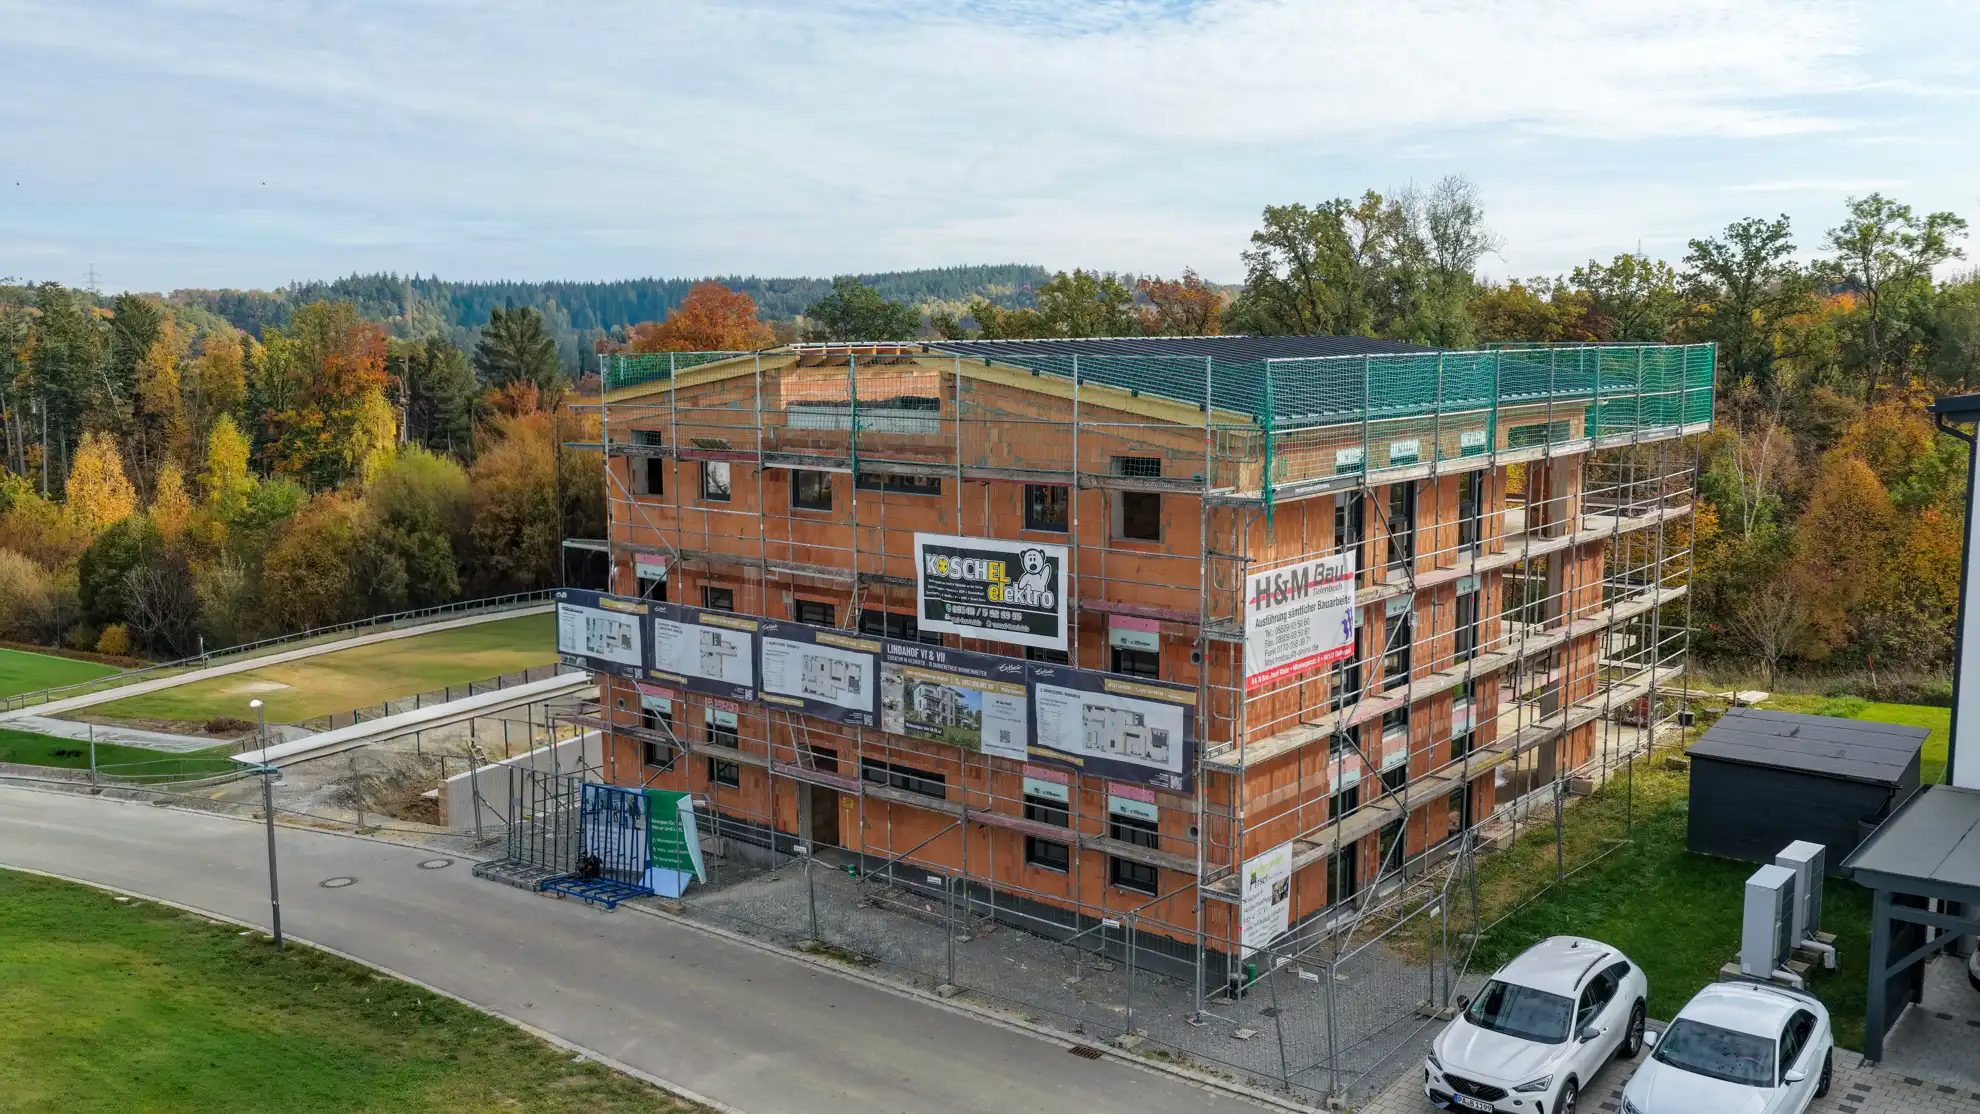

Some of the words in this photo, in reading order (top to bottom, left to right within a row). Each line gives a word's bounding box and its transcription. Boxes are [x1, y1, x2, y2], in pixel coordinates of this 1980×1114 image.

[987, 581, 1055, 609] elektro
[1255, 566, 1309, 611] H&M
[1314, 563, 1343, 585] Bau
[1255, 612, 1287, 629] Ausführung
[1288, 603, 1317, 619] sämtlicher
[887, 643, 919, 658] LINDAHOF
[921, 649, 927, 659] VI
[929, 651, 935, 660] &
[936, 651, 946, 662] VII
[1475, 1101, 1492, 1112] 1199
